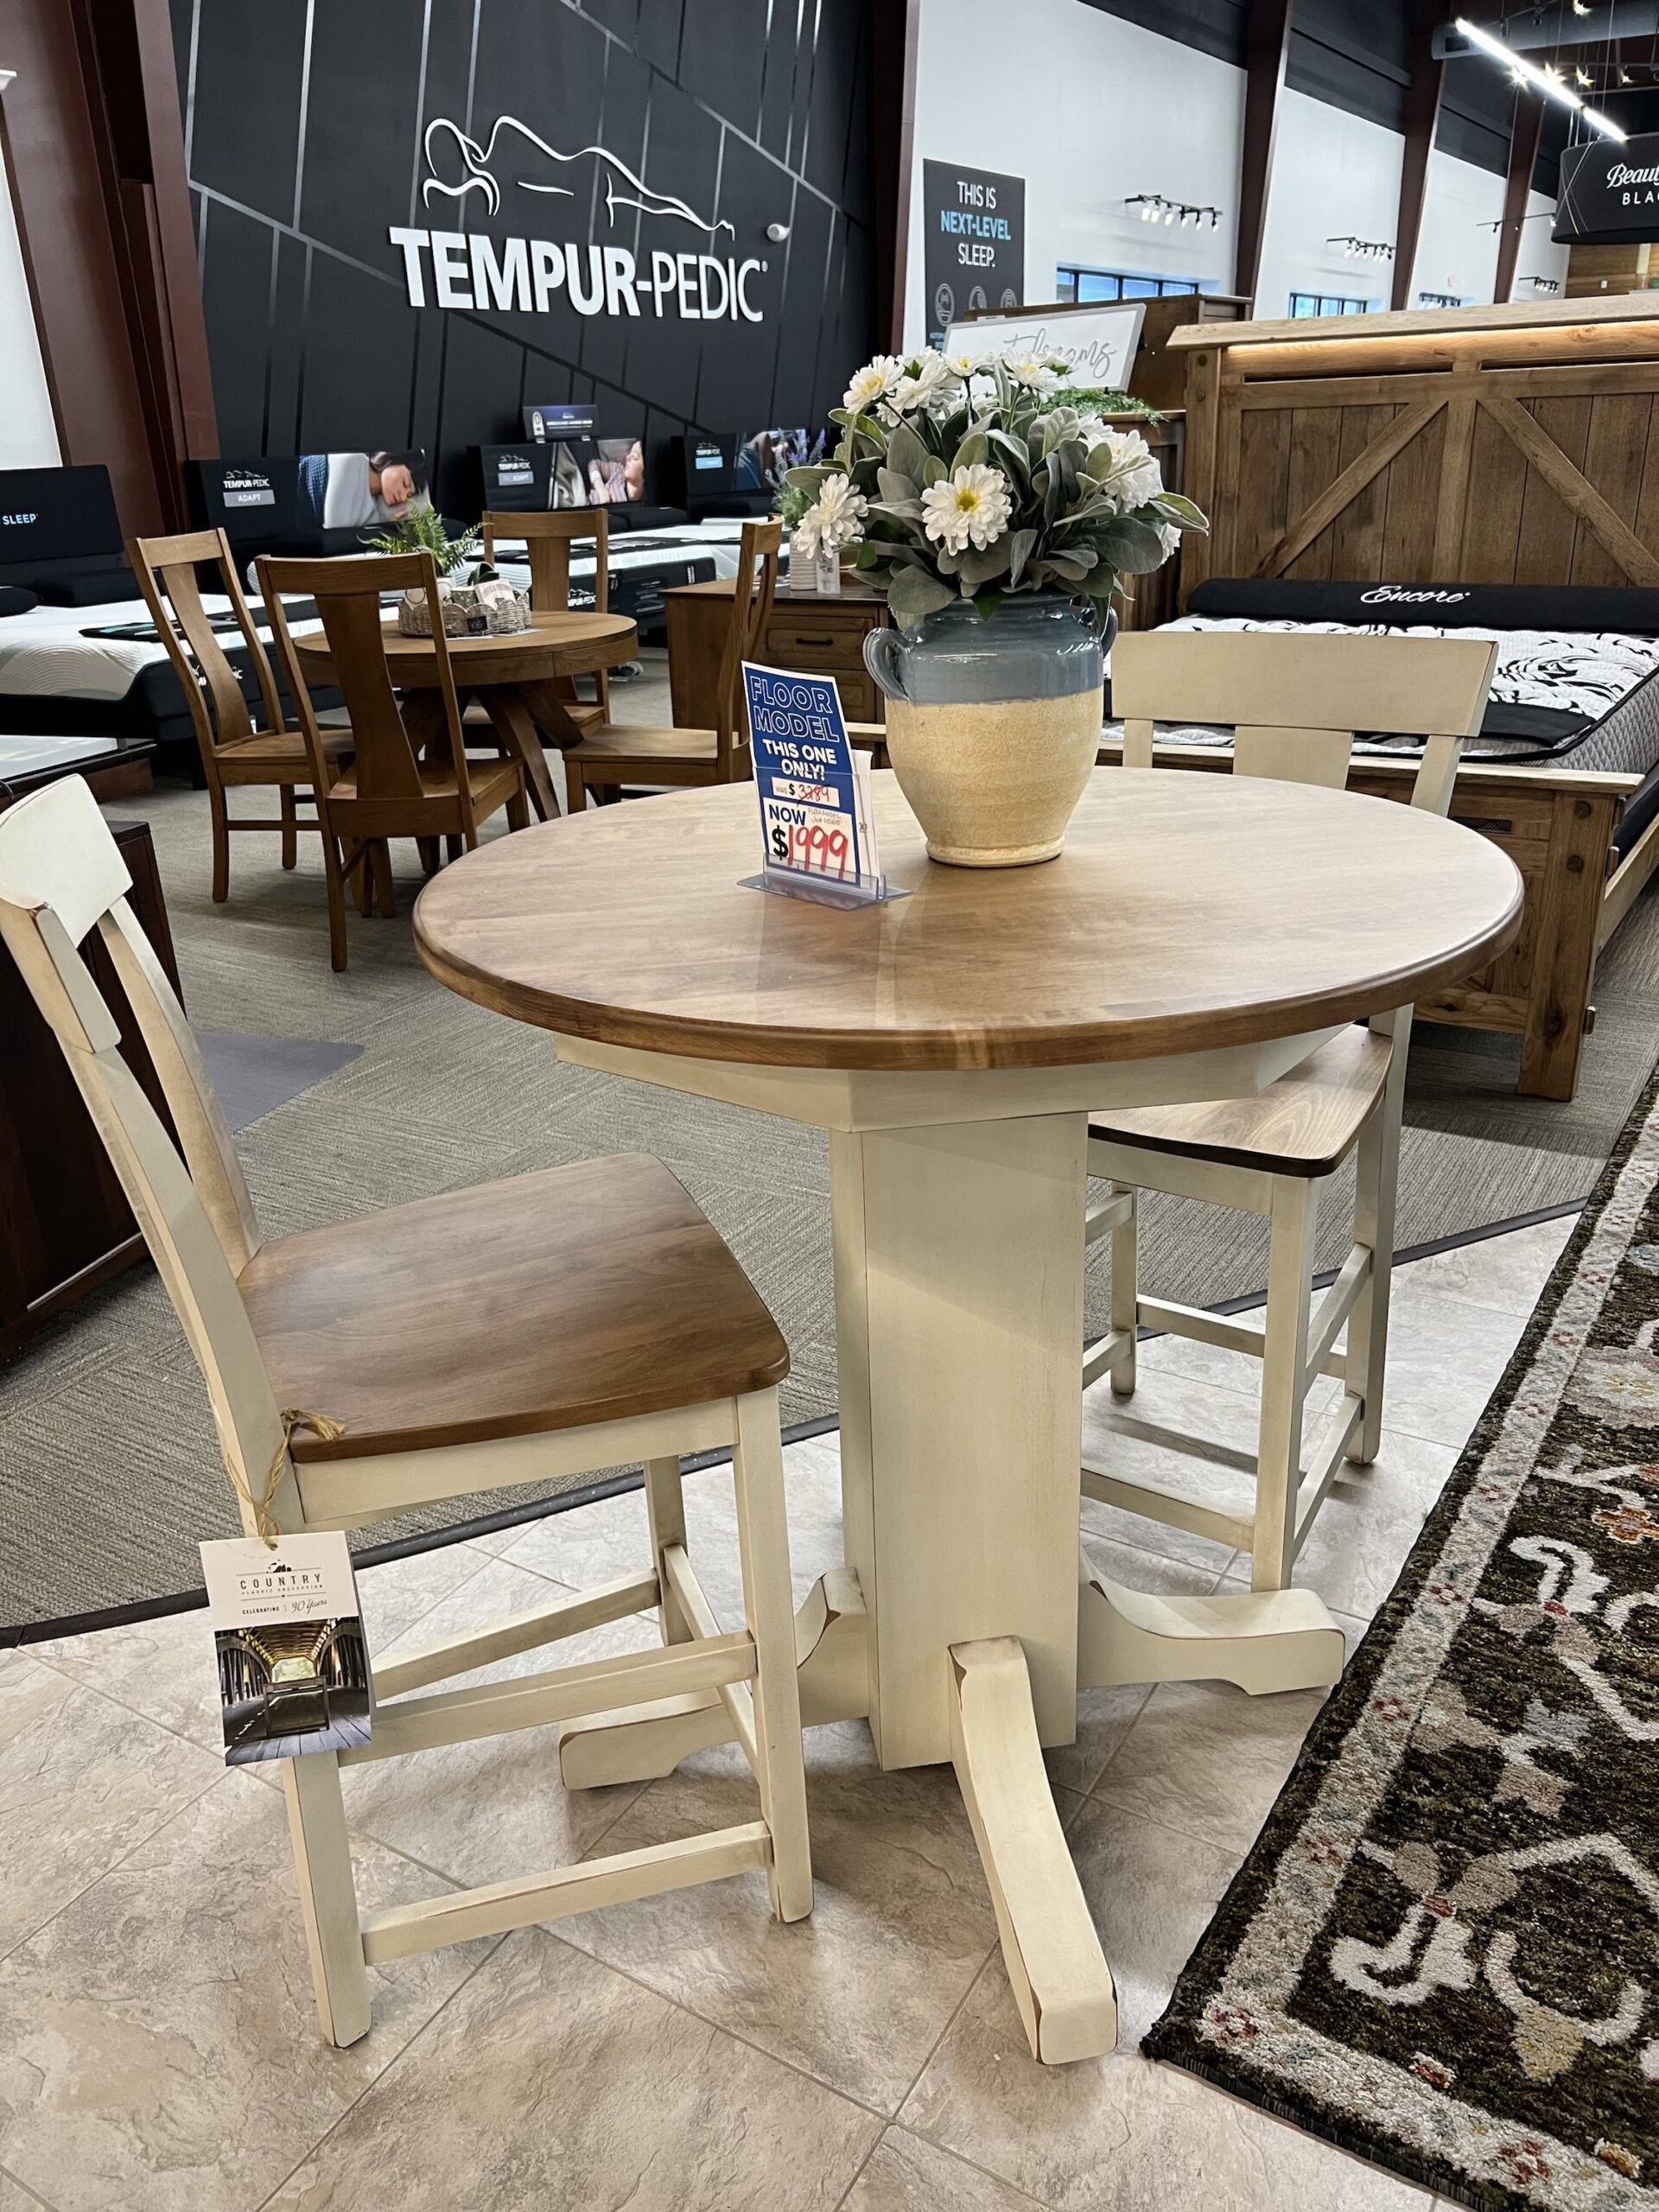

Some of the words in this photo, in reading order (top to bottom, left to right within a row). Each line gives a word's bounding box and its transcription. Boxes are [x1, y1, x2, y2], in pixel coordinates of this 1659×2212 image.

[957, 181, 984, 207] THIS
[986, 187, 997, 209] IS
[1622, 191, 1659, 206] BLA
[941, 210, 1012, 240] NEXT-LEVEL
[958, 243, 996, 268] SLEEP.
[238, 493, 262, 503] ADAPT
[2, 513, 37, 525] SLEEP
[1360, 585, 1468, 604] Encore
[750, 676, 833, 715] FLOOR
[753, 705, 840, 743] MODEL
[762, 739, 799, 759] THIS
[801, 744, 837, 765] ONE
[781, 759, 825, 781] ONLY!
[775, 786, 788, 795] WAS
[768, 804, 806, 826] NOW
[239, 1573, 321, 1590] COUNTRY
[242, 1605, 280, 1615] CELEBRATING
[290, 1599, 306, 1614] 30
